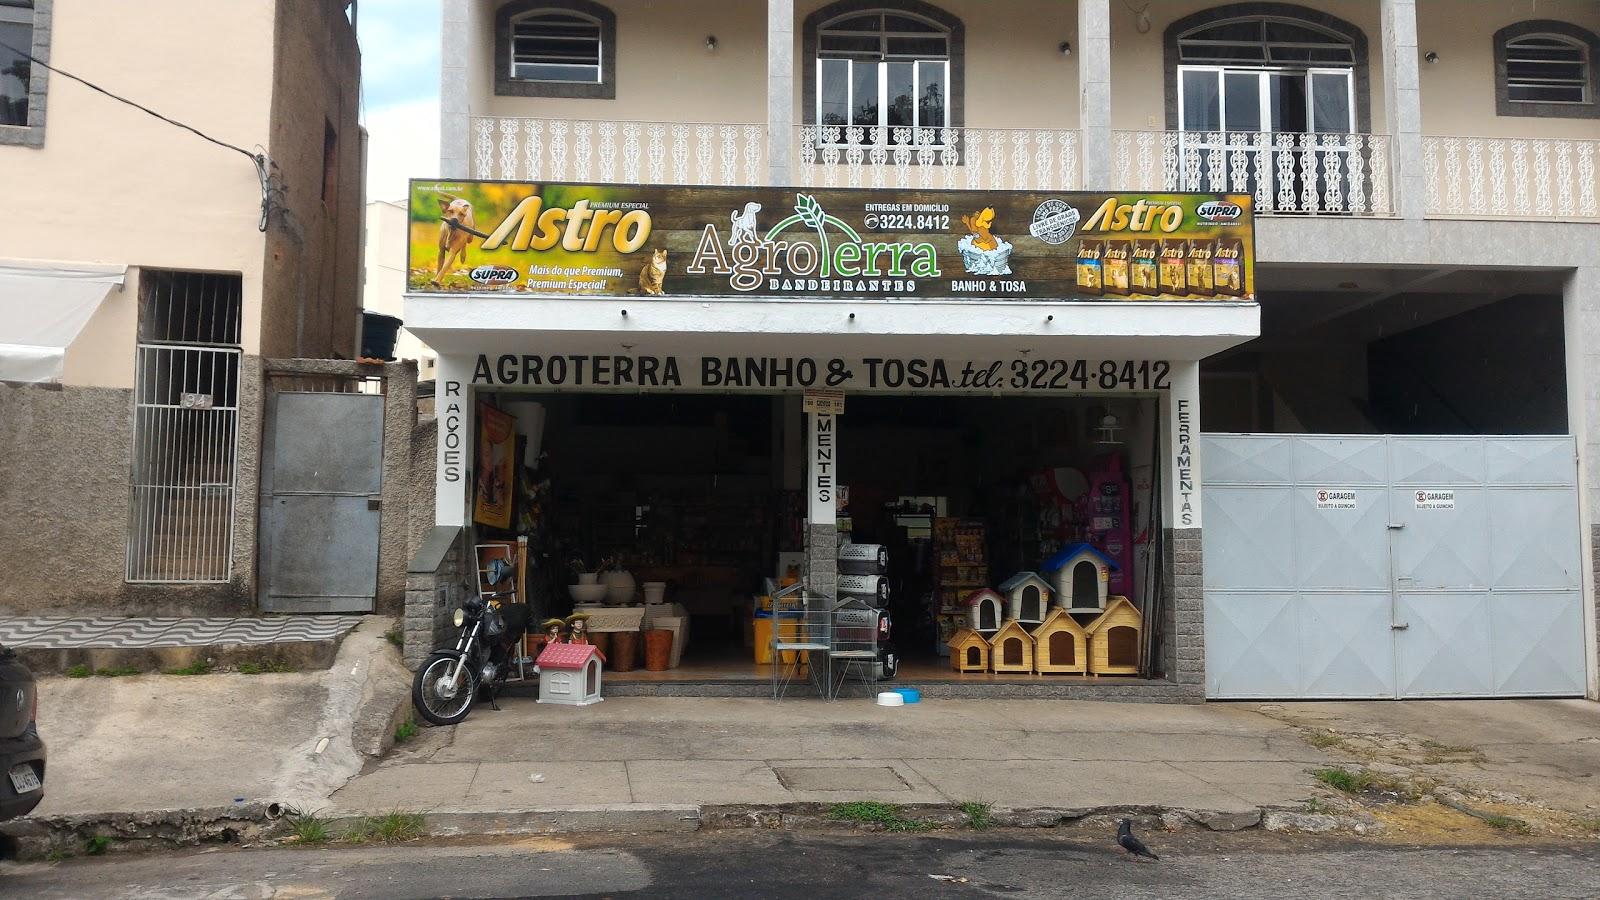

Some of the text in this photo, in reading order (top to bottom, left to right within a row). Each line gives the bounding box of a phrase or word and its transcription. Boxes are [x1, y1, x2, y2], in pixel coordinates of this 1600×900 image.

[865, 203, 949, 212] ENTREGAS EM DOMICÍLIO
[1200, 206, 1238, 216] SUPRA
[1081, 197, 1184, 233] Astro
[480, 196, 652, 254] Astro
[880, 214, 950, 230] 3224.8412
[1077, 248, 1100, 259] Astro
[1104, 248, 1127, 259] Astro
[1132, 248, 1155, 259] Astro
[1160, 248, 1184, 259] Astro
[1188, 248, 1211, 259] Astro
[1214, 248, 1238, 259] Astro
[473, 270, 514, 280] SUPRA
[529, 264, 624, 278] Mais do que Premium,
[527, 278, 606, 292] Premium Especial!
[769, 279, 916, 292] BANDEIRANTES
[951, 280, 1026, 292] BANHO & TOSA
[472, 354, 682, 386] AGROTERRA
[701, 357, 816, 386] BANHO
[825, 358, 854, 386] &
[862, 358, 950, 388] TOSA
[1177, 400, 1193, 526] FERRAMENTAS
[1328, 492, 1355, 500] GARAGEM
